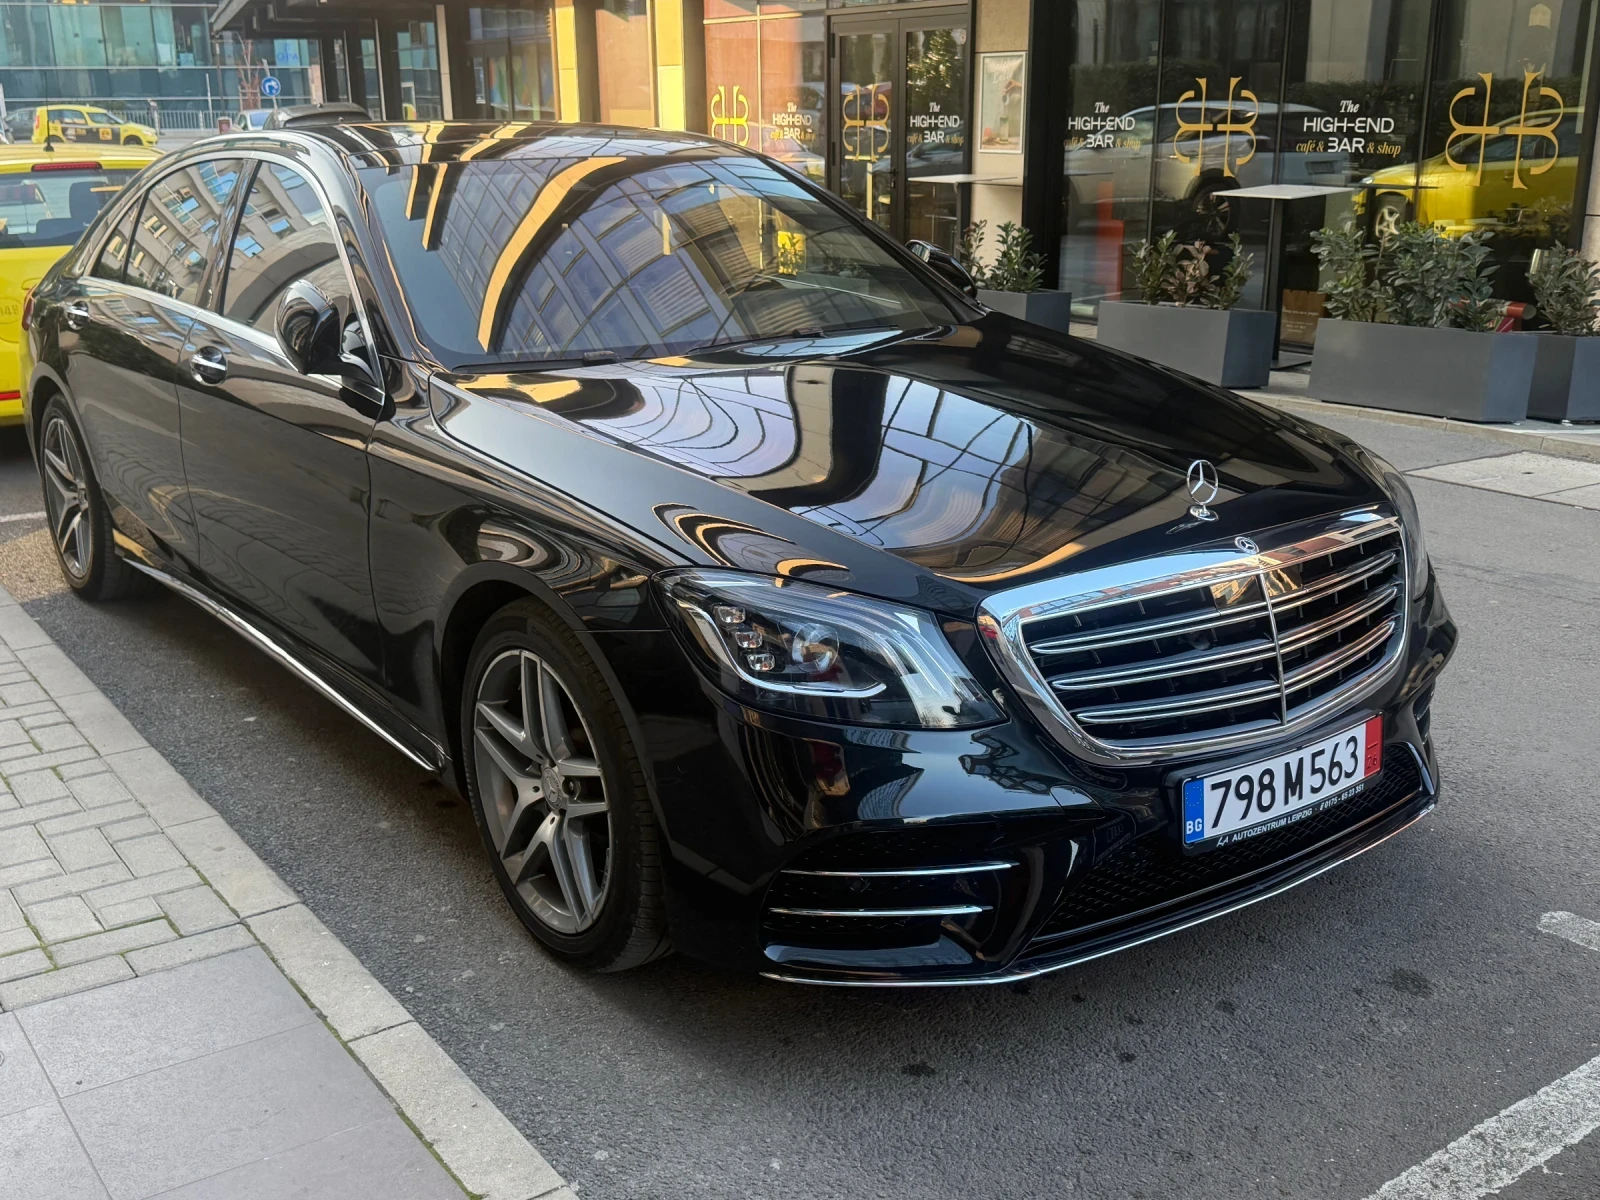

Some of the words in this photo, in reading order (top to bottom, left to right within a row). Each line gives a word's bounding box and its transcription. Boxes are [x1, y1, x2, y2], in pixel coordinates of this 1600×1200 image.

[1094, 101, 1110, 113] The
[1339, 100, 1360, 113] The
[772, 113, 812, 126] HIGH-END
[910, 115, 960, 128] HIGH-END
[1067, 116, 1136, 131] HIGH-END
[1303, 116, 1395, 133] HIGH-END
[1123, 137, 1141, 152] shop
[1296, 140, 1316, 155] café
[1316, 140, 1325, 152] &
[1327, 137, 1365, 153] BAR
[1366, 142, 1375, 154] &
[1376, 142, 1402, 158] shop
[1366, 752, 1378, 769] 26
[1186, 817, 1203, 835] BG
[1232, 817, 1286, 842] AUTOZENTRUM
[1287, 808, 1313, 825] LEIPZIG
